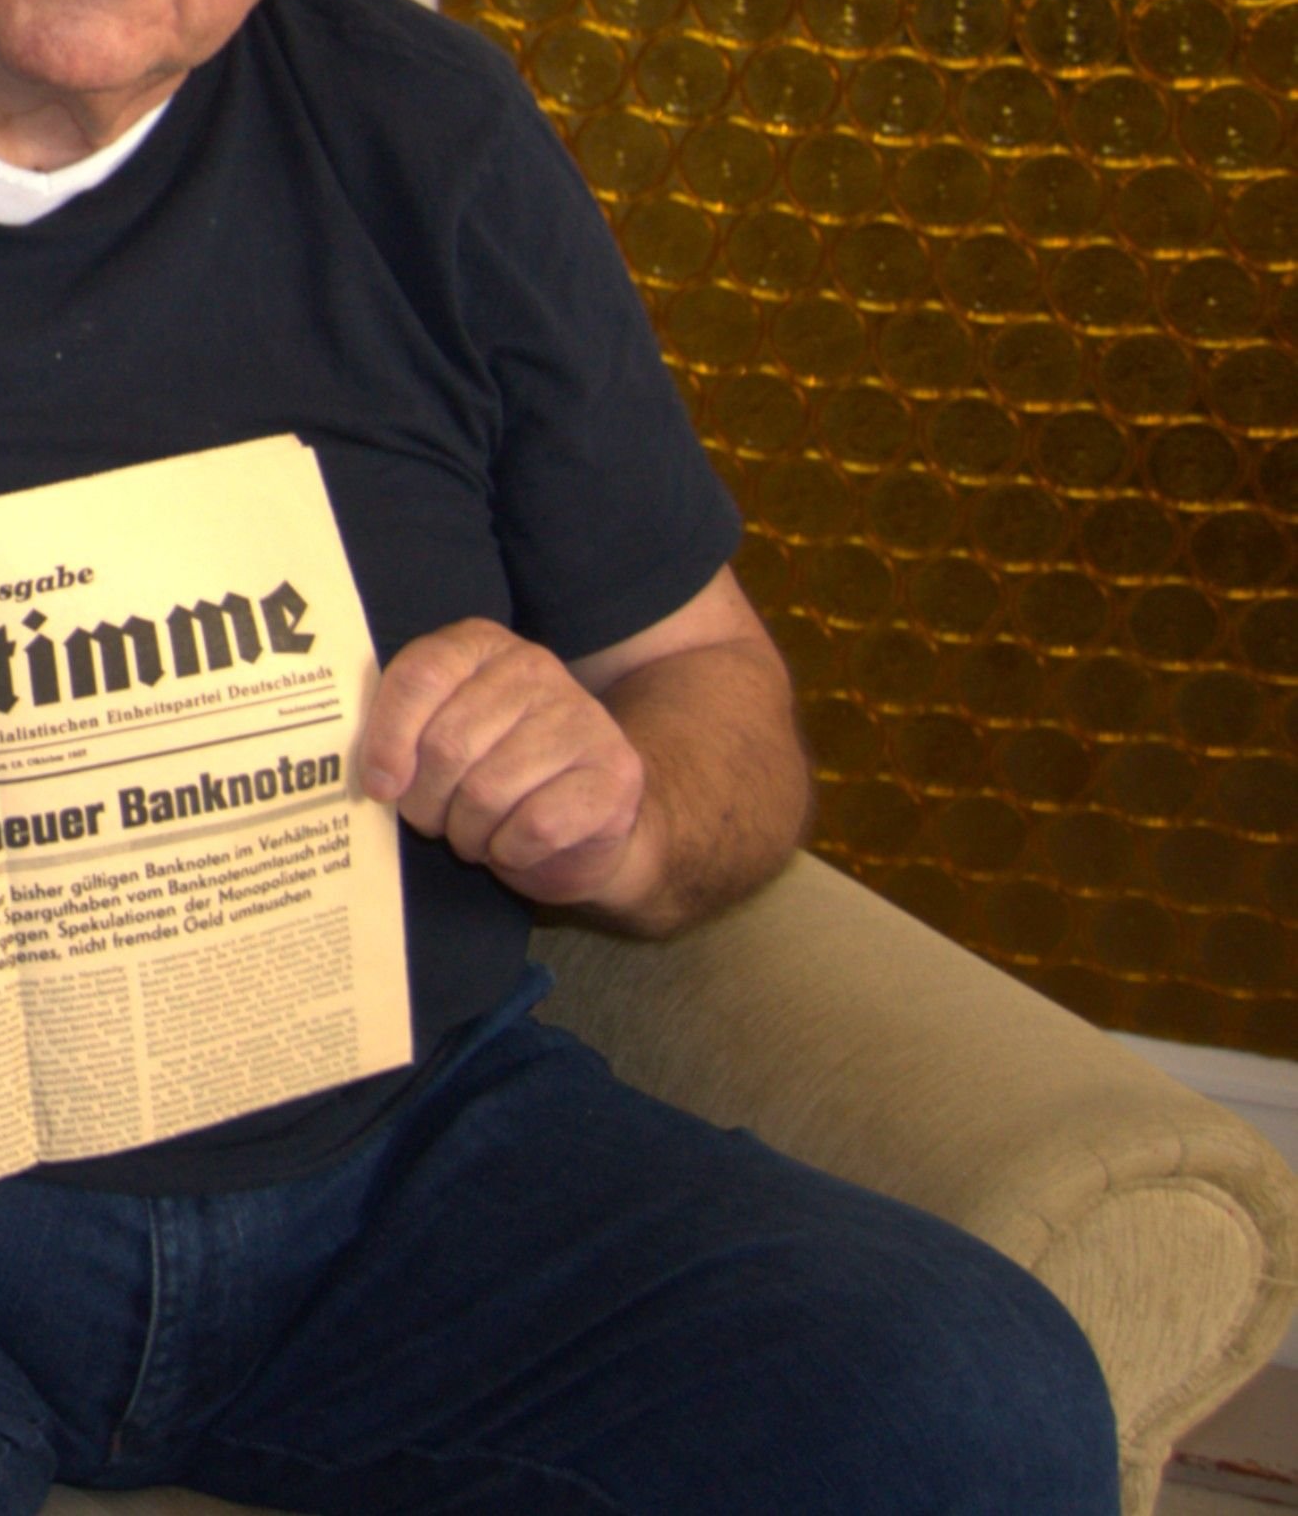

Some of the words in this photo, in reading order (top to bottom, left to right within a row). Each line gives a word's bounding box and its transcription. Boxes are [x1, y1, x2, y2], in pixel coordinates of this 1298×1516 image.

[106, 689, 221, 724] Einheitspartei
[227, 665, 332, 699] Deutschlands
[117, 753, 339, 829] Banknoten
[9, 882, 63, 903] bisher
[70, 870, 139, 897] gültigen
[144, 852, 230, 879] Banknoten
[234, 845, 252, 859] im
[258, 823, 329, 851] Verhältnis
[57, 905, 176, 939] Spekulationen
[183, 896, 210, 913] der
[218, 867, 316, 904] Monopolisten
[322, 852, 350, 873] und
[126, 887, 163, 903] vom
[167, 844, 314, 896] Banknotenumtausch
[317, 834, 349, 854] nicht
[68, 936, 106, 956] nicht
[112, 923, 178, 948] fremdes
[182, 910, 223, 933] Geld
[229, 888, 311, 922] umtauschen
